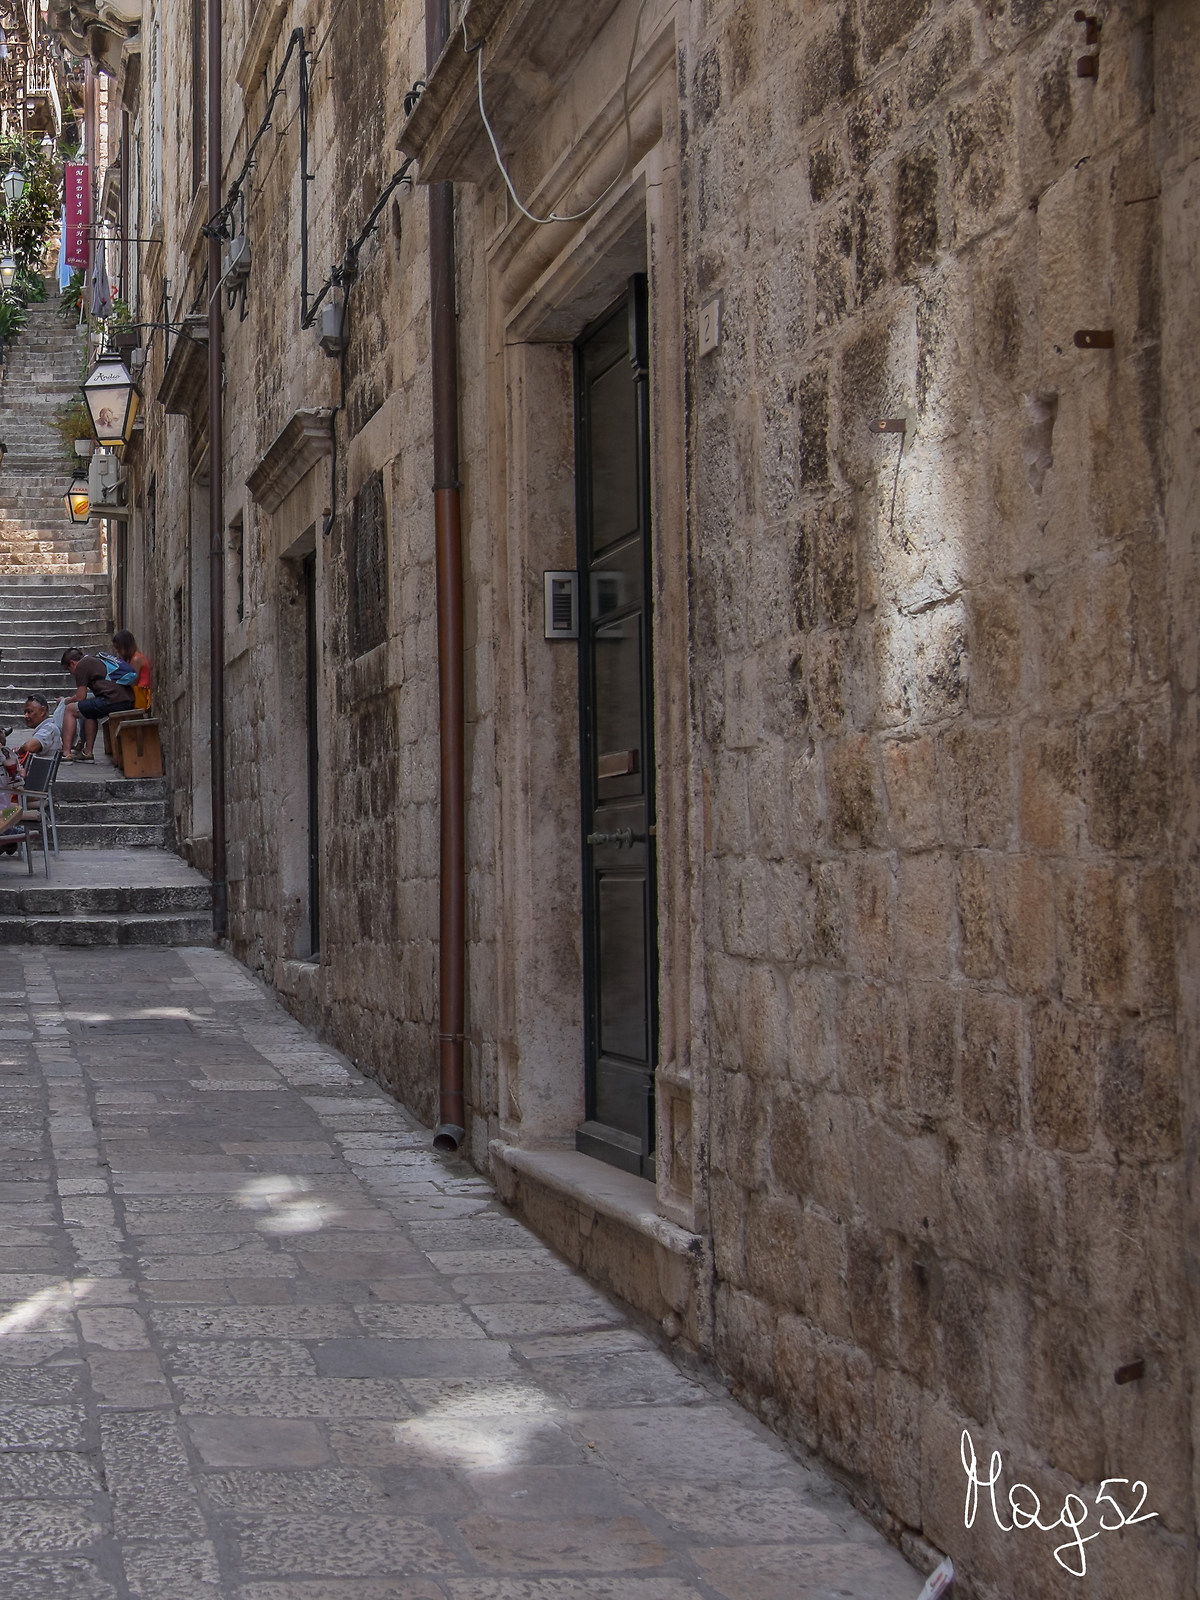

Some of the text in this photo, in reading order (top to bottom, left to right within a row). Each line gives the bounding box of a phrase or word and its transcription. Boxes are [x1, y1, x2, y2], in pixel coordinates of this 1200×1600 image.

[75, 169, 84, 255] MEDUSA SHOP
[704, 314, 710, 344] 2
